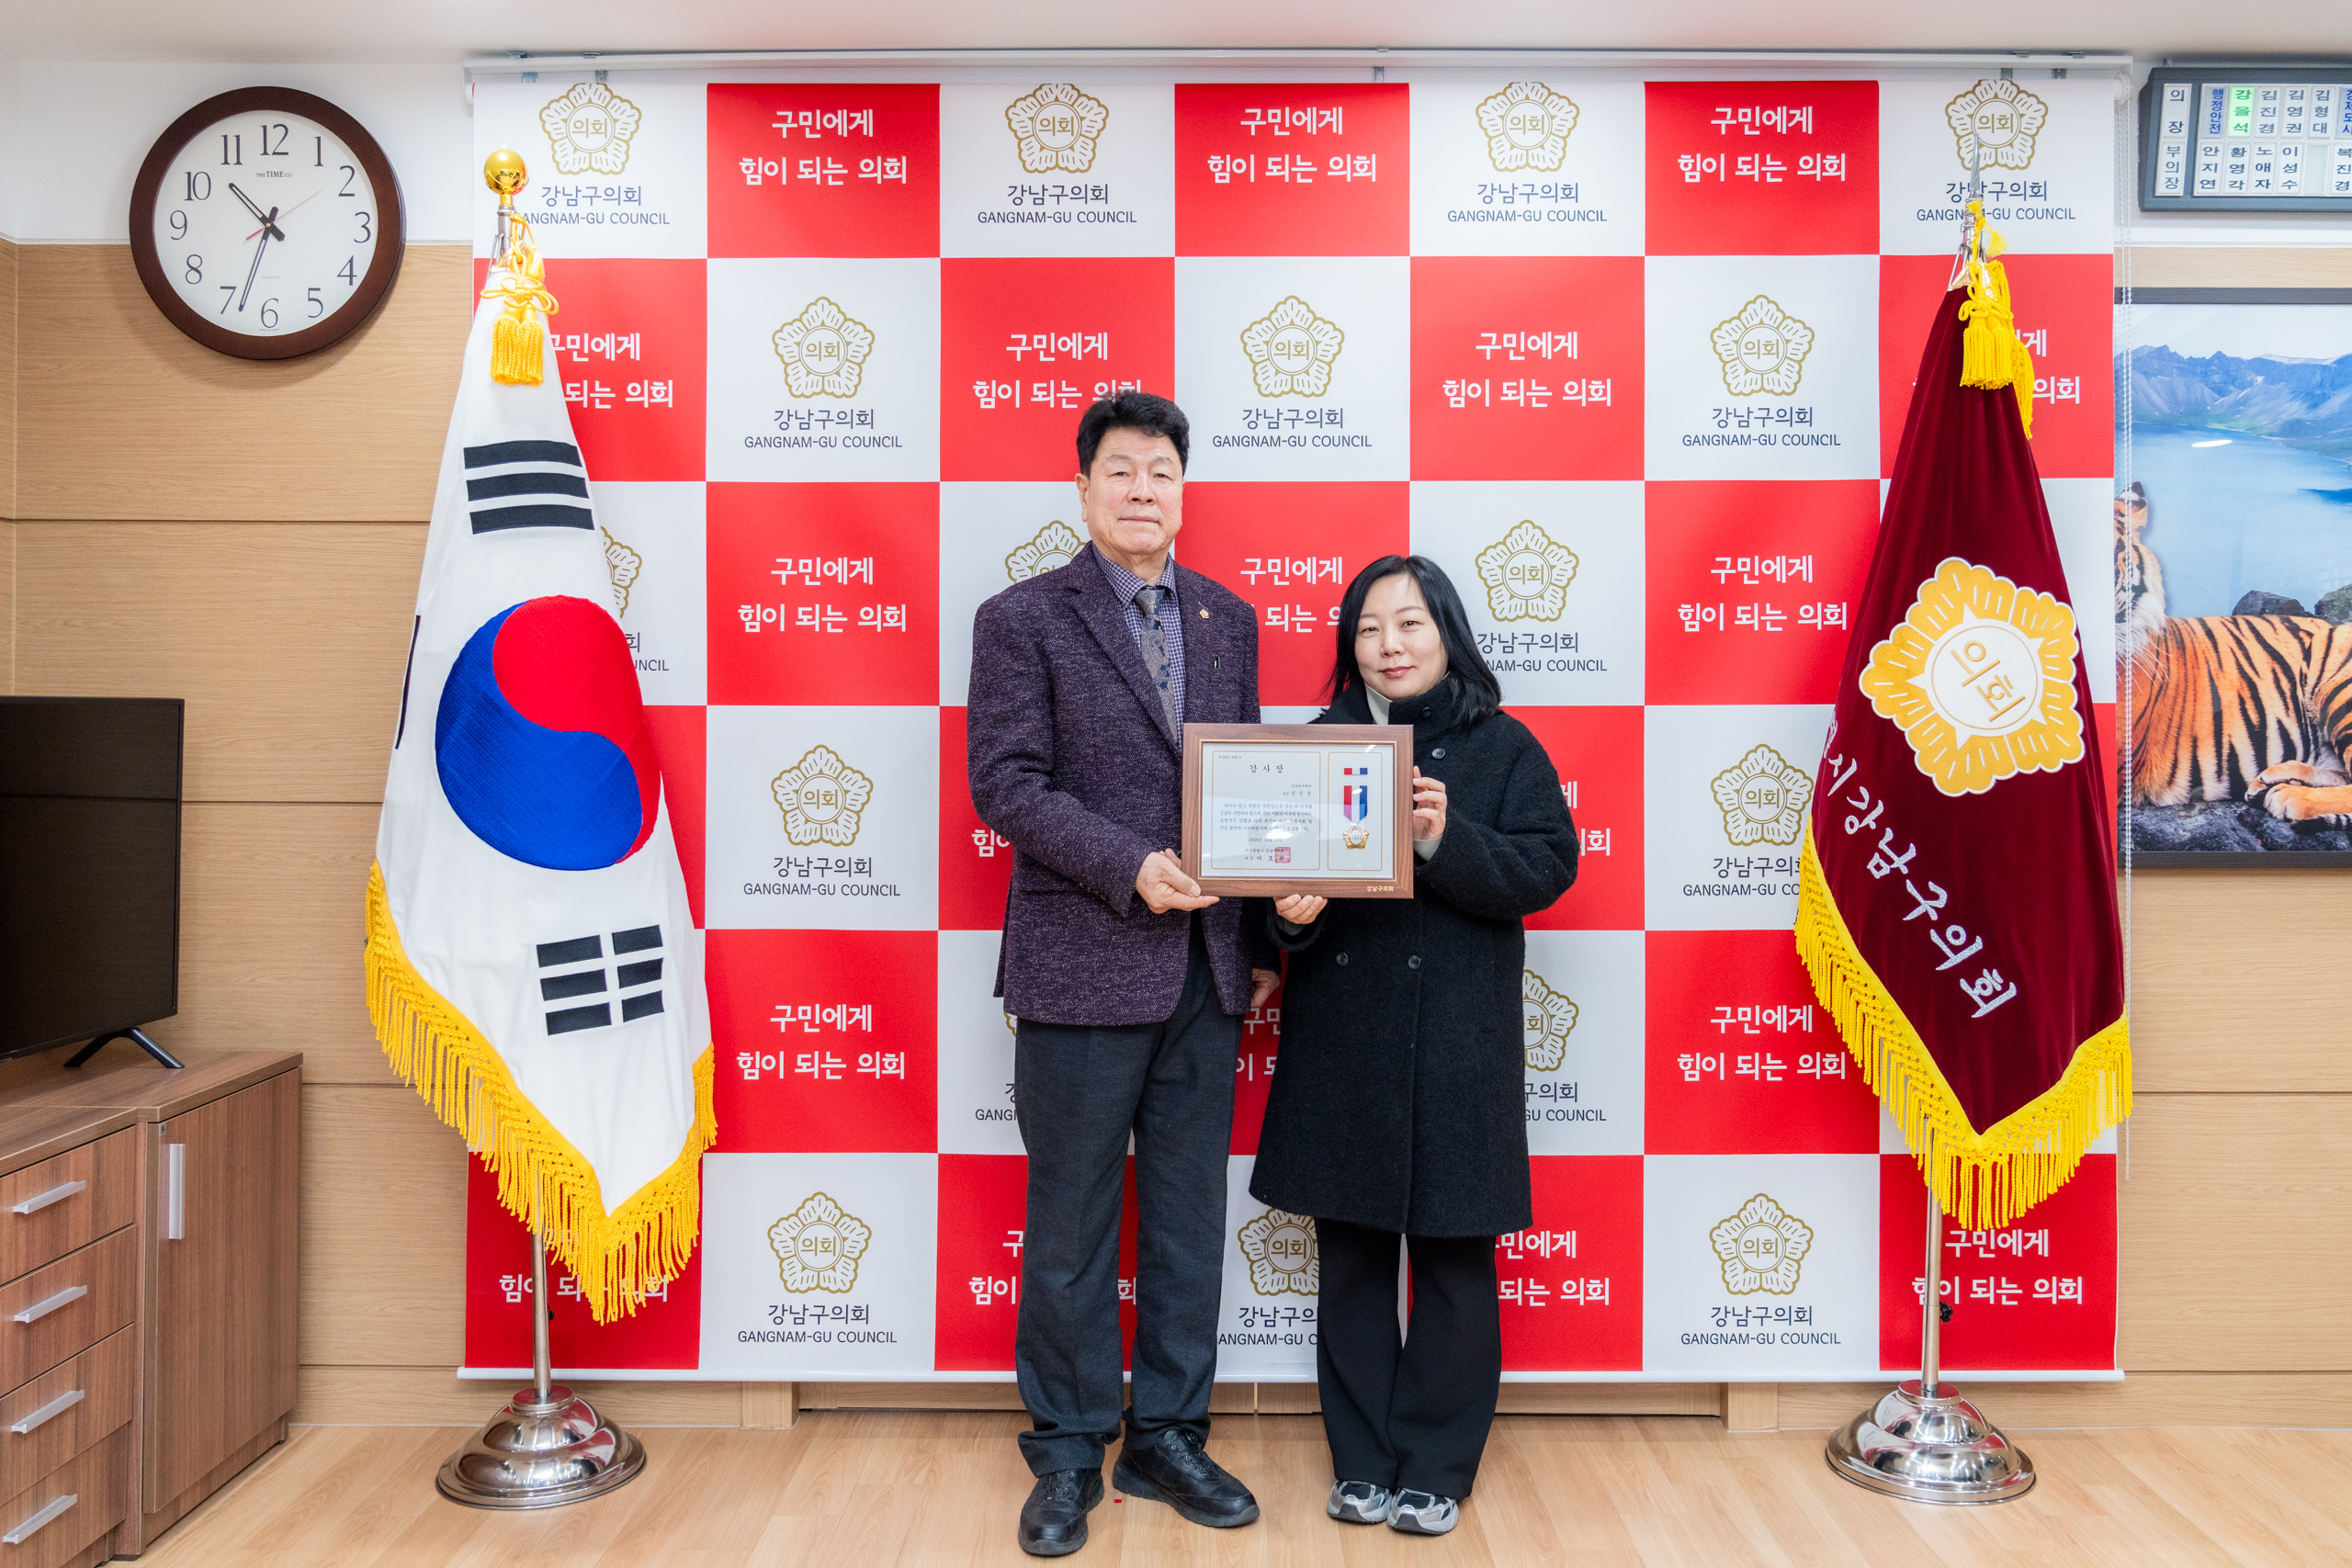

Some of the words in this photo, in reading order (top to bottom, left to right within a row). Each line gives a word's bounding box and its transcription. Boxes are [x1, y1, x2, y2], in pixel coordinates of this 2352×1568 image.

[772, 109, 873, 138] 구민에게
[1240, 107, 1342, 135] 구민에게
[1711, 107, 1812, 135] 구민에게
[1978, 114, 2013, 133] 의회
[2209, 88, 2224, 134] 행정안전
[2258, 90, 2278, 134] 김진경
[2285, 90, 2305, 133] 김영권
[2312, 90, 2330, 134] 김형대
[260, 124, 288, 155] 12
[572, 118, 608, 139] 의회
[1039, 116, 1074, 137] 의회
[1509, 115, 1544, 136] 의회
[221, 135, 243, 164] 11
[314, 136, 323, 166] 1
[338, 165, 355, 197] 2
[740, 157, 786, 185] 힘이
[797, 157, 848, 186] 되는
[858, 156, 906, 184] 의회
[1207, 154, 1254, 183] 힘이
[1266, 154, 1317, 183] 되는
[1328, 154, 1375, 182] 의회
[1678, 153, 1724, 182] 힘이
[1736, 153, 1787, 182] 되는
[1797, 153, 1845, 181] 의회
[2165, 146, 2181, 189] 부의장
[2199, 146, 2220, 189] 안지연
[2228, 147, 2247, 190] 황영각
[2255, 146, 2273, 189] 노애자
[2281, 146, 2299, 189] 이성수
[2335, 147, 2352, 191] 복진경
[185, 172, 211, 200] 10
[542, 186, 640, 207] 강남구의회
[1008, 184, 1107, 206] 강남구의회
[1477, 183, 1577, 204] 강남구의회
[170, 210, 187, 240] 9
[355, 212, 370, 243] 3
[523, 213, 605, 224] ANGNAM-GU
[610, 213, 670, 224] COUNCIL
[978, 212, 1071, 223] GANGNAM-GU
[1078, 211, 1136, 222] COUNCIL
[1448, 210, 1541, 221] GANGNAM-GU
[1547, 210, 1607, 221] COUNCIL
[1917, 209, 2010, 220] GANGN-GU
[2017, 209, 2075, 220] COUNCIL
[186, 254, 202, 284] 8
[336, 254, 357, 287] 4
[220, 286, 237, 314] 7
[261, 298, 279, 328] 6
[307, 288, 323, 319] 5
[805, 342, 841, 363] 의회
[1006, 333, 1107, 361] 구민에게
[1274, 340, 1309, 362] 의회
[1476, 332, 1577, 360] 구민에게
[1744, 339, 1781, 359] 의회
[564, 379, 616, 409] 되는
[626, 380, 673, 408] 의회
[973, 380, 1020, 409] 힘이
[1031, 380, 1082, 408] 되는
[1442, 379, 1489, 408] 힘이
[1500, 379, 1552, 407] 되는
[1563, 378, 1611, 406] 의회
[2032, 376, 2080, 404] 의회
[775, 409, 873, 430] 강남구의회
[1242, 408, 1342, 429] 강남구의회
[1713, 407, 1812, 428] 강남구의회
[745, 436, 836, 447] GANGNAM-GU
[842, 436, 902, 447] COUNCIL
[1213, 435, 1306, 446] GANGNAM-GU
[1312, 435, 1372, 446] COUNCIL
[1683, 434, 1776, 446] GANGNAM-GU
[1782, 434, 1840, 446] COUNCIL
[771, 558, 873, 585] 구민에게
[1240, 557, 1342, 585] 구민에게
[1509, 564, 1544, 585] 의회
[1711, 555, 1813, 584] 구민에게
[738, 604, 785, 632] 힘이
[796, 604, 847, 632] 되는
[858, 604, 906, 632] 의회
[1265, 604, 1317, 632] 되는
[1678, 604, 1724, 632] 힘이
[1735, 603, 1787, 631] 되는
[1798, 603, 1847, 630] 의회
[1477, 632, 1578, 654] 강남구의회
[1486, 660, 1542, 671] NAM-GU
[1547, 660, 1607, 671] COUNCIL
[1951, 640, 2026, 723] 의회
[803, 789, 838, 810] 의회
[1745, 788, 1781, 809] 의회
[774, 856, 871, 877] 강남구의회
[744, 884, 835, 895] GANGNAM-GU
[842, 885, 900, 896] COUNCIL
[1683, 884, 1776, 896] GANGNAM-GU
[771, 1004, 872, 1032] 구민에게
[1711, 1005, 1812, 1033] 구민에게
[737, 1051, 784, 1079] 힘이
[795, 1051, 846, 1079] 되는
[857, 1052, 904, 1079] 의회
[1678, 1053, 1724, 1081] 힘이
[1736, 1053, 1787, 1081] 되는
[1797, 1052, 1845, 1079] 의회
[1525, 1082, 1577, 1102] 구의회
[1546, 1110, 1606, 1121] COUNCIL
[800, 1237, 836, 1258] 의회
[1271, 1238, 1307, 1259] 의회
[1498, 1231, 1577, 1258] 민에게
[1743, 1237, 1779, 1258] 의회
[1945, 1229, 2049, 1258] 구민에게
[499, 1274, 533, 1303] 힘
[968, 1276, 1016, 1304] 힘이
[1498, 1278, 1551, 1306] 되는
[1561, 1278, 1609, 1305] 의회
[1970, 1277, 2022, 1305] 되는
[2033, 1277, 2082, 1304] 의회
[768, 1304, 868, 1325] 강남구의회
[1238, 1306, 1317, 1327] 강남구의
[1711, 1305, 1812, 1327] 강남구의회
[739, 1331, 831, 1342] GANGNAM-GU
[837, 1332, 897, 1343] COUNCIL
[1218, 1334, 1303, 1345] ANGNAM-GU
[1681, 1333, 1775, 1345] GANGNAM-GU
[1781, 1333, 1840, 1344] COUNCIL
